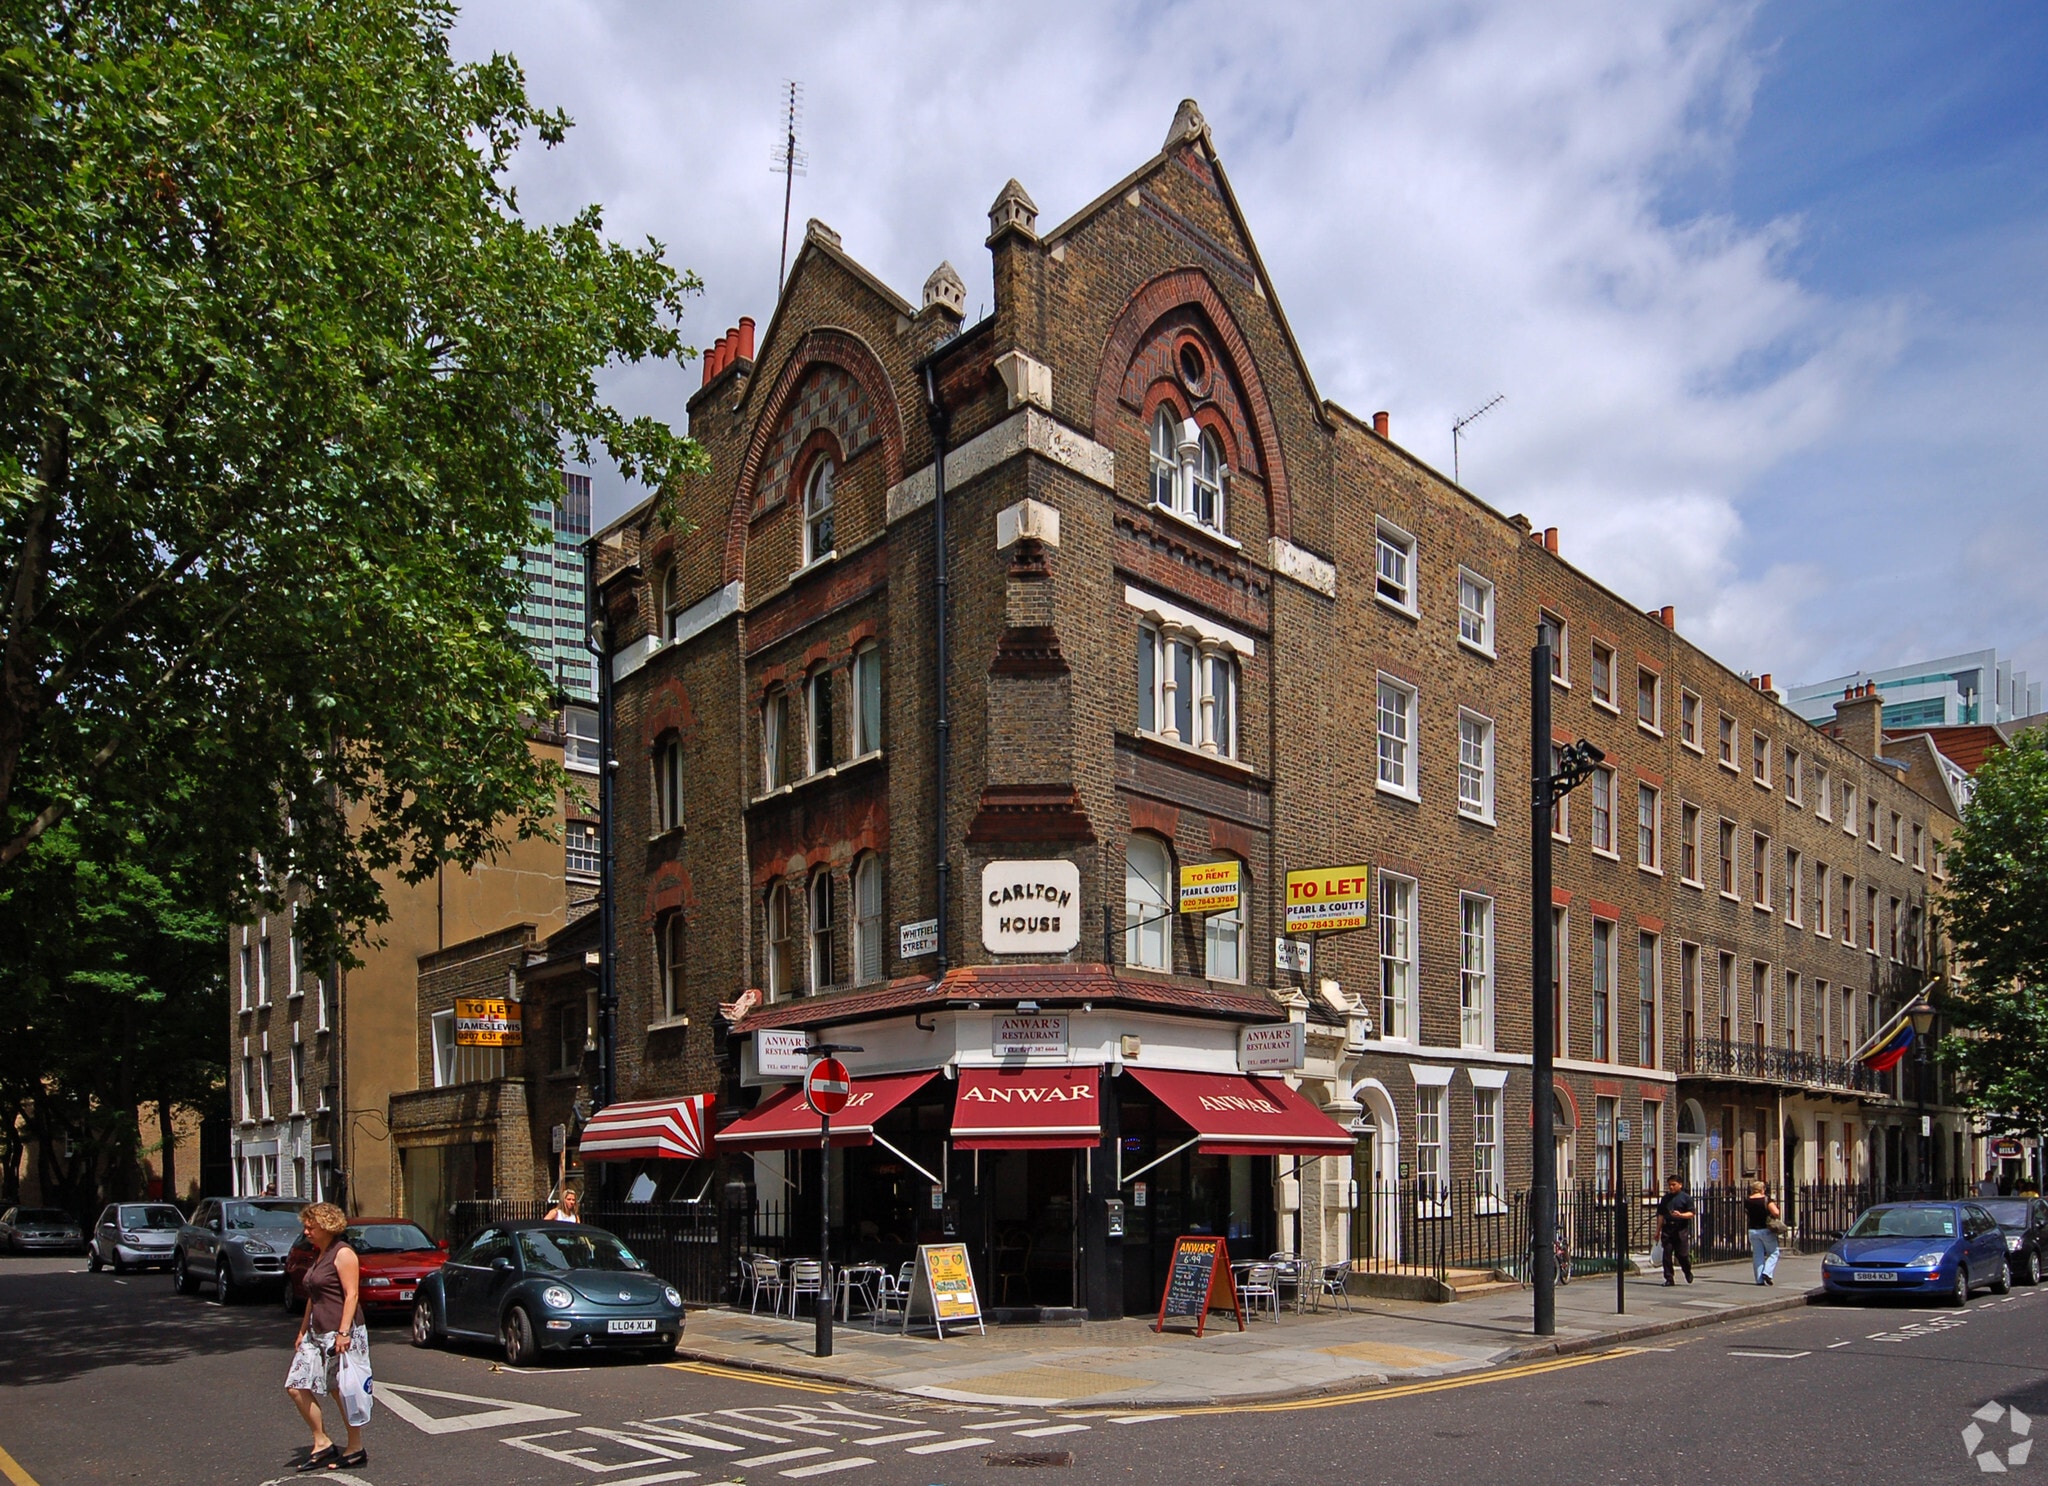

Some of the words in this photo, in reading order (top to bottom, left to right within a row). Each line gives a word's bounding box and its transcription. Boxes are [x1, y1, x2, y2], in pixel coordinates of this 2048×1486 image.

[1206, 871, 1230, 880] RENT
[1182, 888, 1202, 896] PEARL
[1211, 884, 1236, 893] COUTTS
[1289, 882, 1318, 899] TO
[1326, 878, 1365, 896] LET
[988, 883, 1072, 908] CARLTON
[1288, 905, 1316, 915] PEARL
[1329, 901, 1365, 910] COUTTS
[1000, 916, 1060, 934] HOUSE
[1291, 922, 1308, 930] 020
[1311, 920, 1334, 929] 7843
[1337, 918, 1360, 927] 3788
[903, 940, 928, 952] STREET
[1278, 944, 1308, 956] GRAFTON
[1279, 954, 1292, 964] WAY
[465, 1004, 484, 1013] TO
[489, 1005, 512, 1014] LET
[492, 1023, 520, 1031] LEWIS
[1002, 1018, 1060, 1029] ANWAR'S
[1002, 1031, 1060, 1040] RESTAURANT
[1246, 1030, 1291, 1041] ANWAR'S
[765, 1036, 810, 1047] ANWAR'S
[1246, 1042, 1290, 1051] RESTAURANT
[766, 1048, 804, 1056] RESTAU
[961, 1084, 1095, 1103] ANWAR
[1198, 1095, 1282, 1114] ANWAR
[612, 1322, 634, 1330] LL04
[637, 1321, 653, 1330] XLM
[500, 1401, 926, 1472] ENTRY
